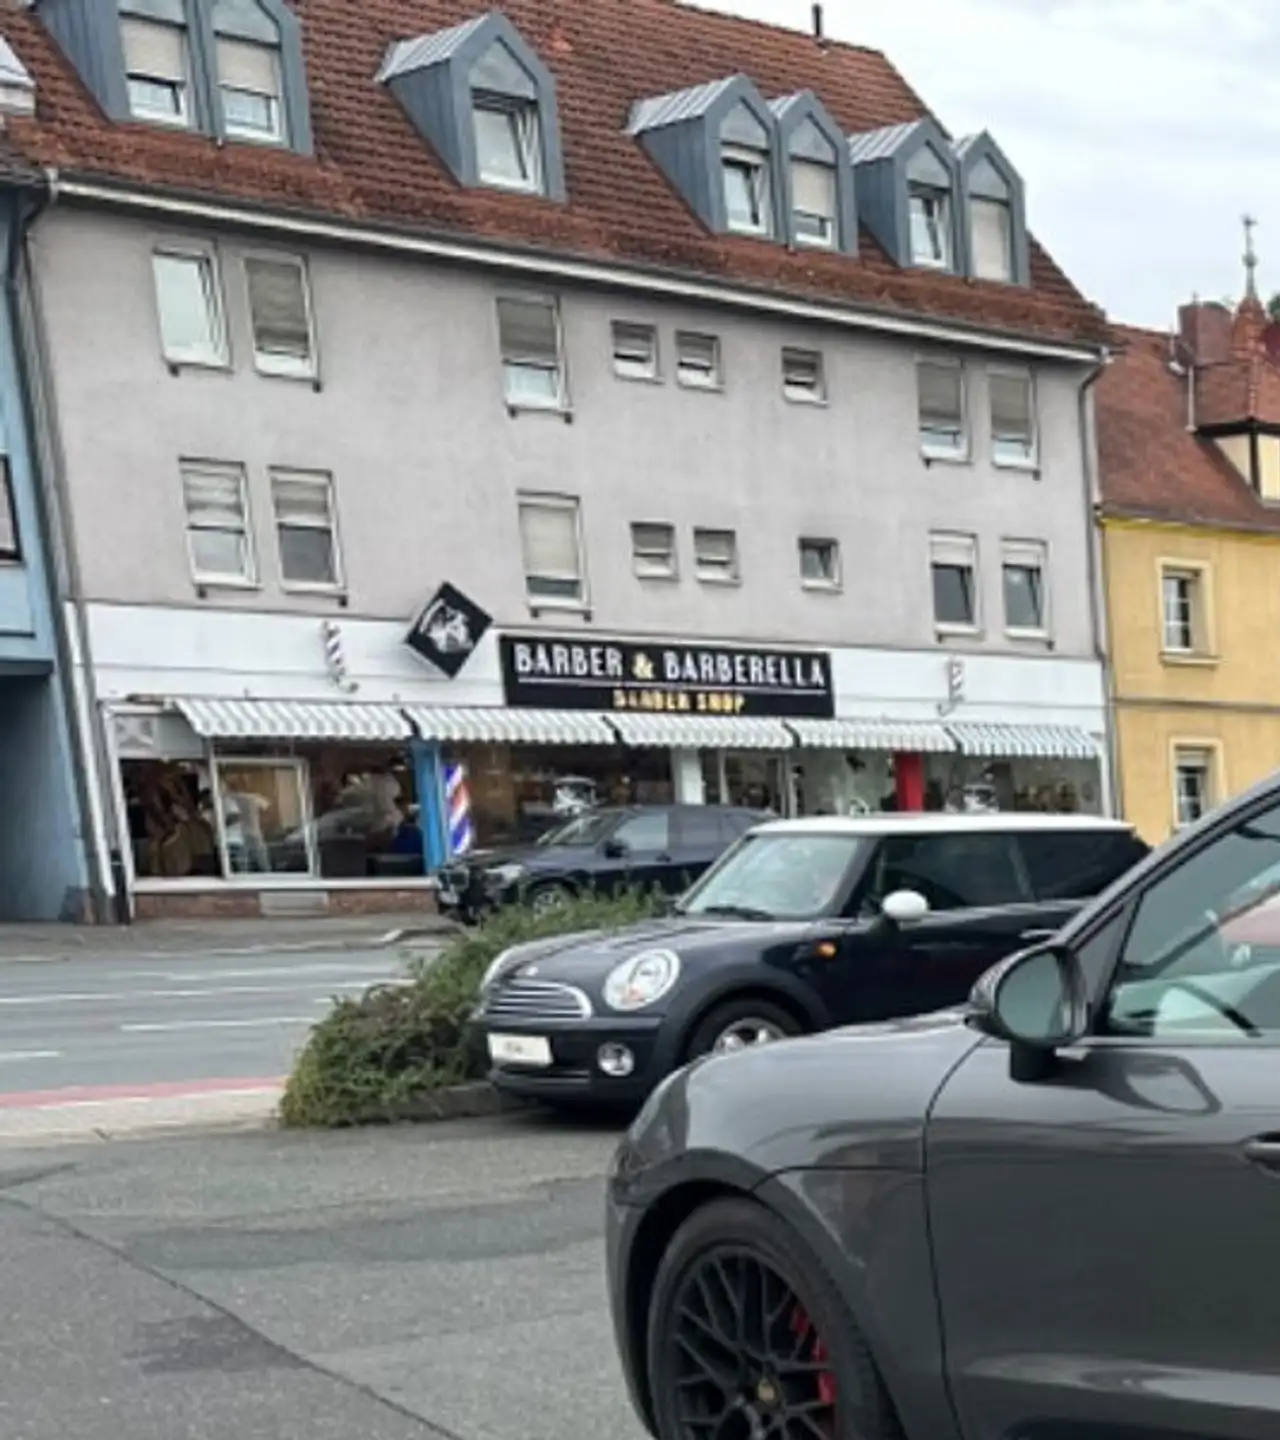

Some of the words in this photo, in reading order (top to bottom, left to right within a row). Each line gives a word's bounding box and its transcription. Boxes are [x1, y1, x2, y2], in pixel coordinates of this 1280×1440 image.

[513, 643, 622, 676] BARBER
[631, 653, 655, 680] &
[662, 650, 825, 688] BARBERELLA
